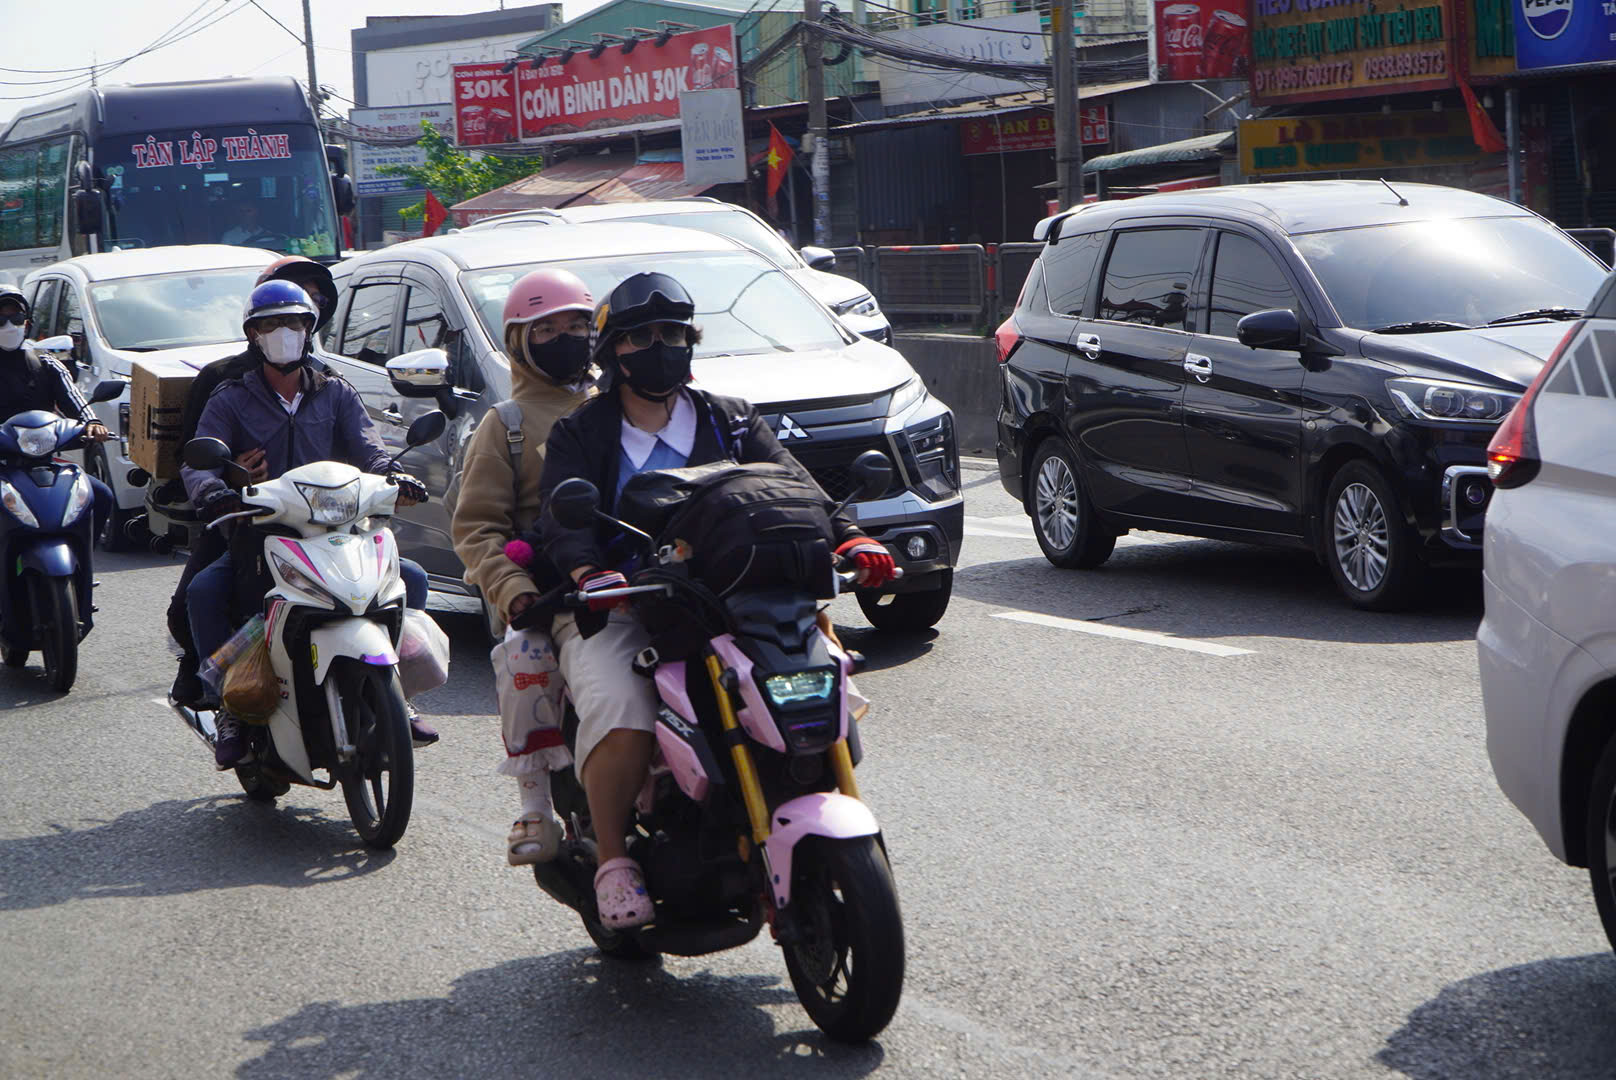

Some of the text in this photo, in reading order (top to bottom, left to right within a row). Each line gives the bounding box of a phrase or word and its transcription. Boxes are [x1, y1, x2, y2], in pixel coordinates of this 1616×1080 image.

[1525, 0, 1570, 8] PEP
[1326, 17, 1357, 54] QUAY
[1364, 50, 1444, 79] 0938.893573
[460, 79, 510, 99] 30K
[522, 84, 560, 120] CƠM
[563, 75, 607, 115] BÌNH
[608, 66, 650, 108] DÂN
[652, 66, 689, 102] 30K
[132, 128, 291, 169] TÂN LẬP THÀNH
[659, 709, 694, 737] MSX
